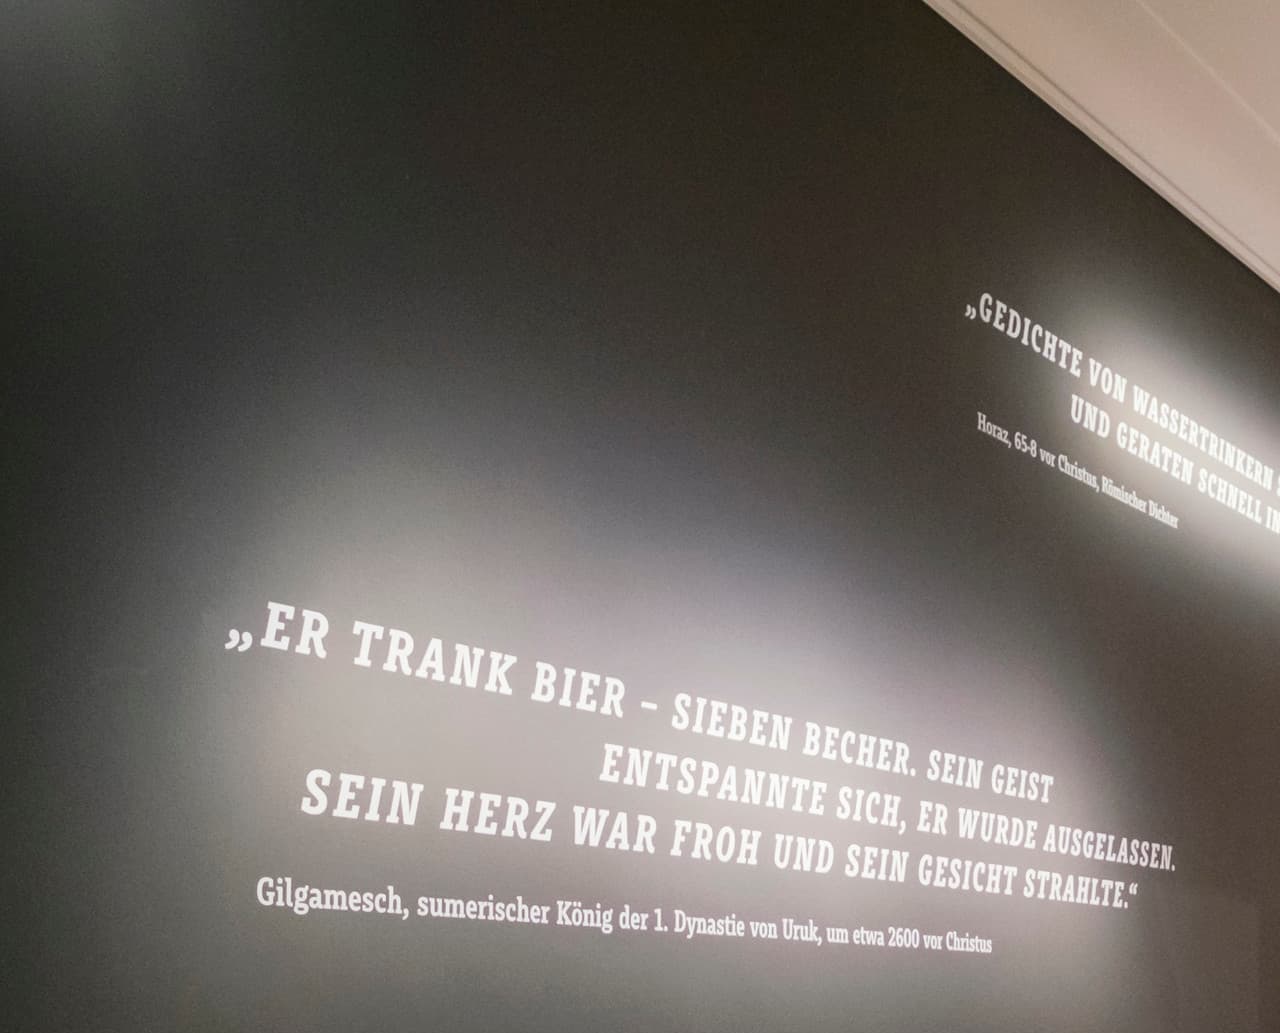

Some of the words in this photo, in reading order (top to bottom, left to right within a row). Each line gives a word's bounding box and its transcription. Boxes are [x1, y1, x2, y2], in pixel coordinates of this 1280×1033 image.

[977, 412, 1011, 449] Horaz,
[1014, 432, 1037, 458] 65-8
[1039, 448, 1055, 468] vor
[1058, 455, 1100, 492] Christus,
[1102, 476, 1147, 514] Römischer
[1148, 500, 1179, 529] Dichter
[1071, 395, 1110, 439] UND
[1117, 423, 1192, 485] GERATEN
[1199, 469, 1262, 524] SCHNELL
[1266, 505, 1280, 534] IN
[1089, 358, 1127, 403] VON
[1133, 385, 1273, 488] WASSERTRINKERN
[353, 621, 517, 695] TRANK
[531, 661, 625, 718] BIER
[671, 693, 792, 751] SIEBEN
[803, 721, 916, 776] BECHER.
[927, 750, 983, 789] SEIN
[991, 764, 1054, 803] GEIST
[301, 769, 424, 826] SEIN
[440, 787, 556, 841] HERZ
[572, 806, 657, 853] WAR
[670, 820, 762, 865] FROH
[773, 833, 834, 873] UND
[845, 844, 908, 882] SEIN
[918, 855, 1018, 896] GESICHT
[599, 743, 827, 816] ENTSPANNTE
[836, 786, 906, 835] SICH,
[917, 800, 948, 835] ER
[958, 807, 1038, 849] WURDE
[1043, 824, 1175, 871] AUSGELASSEN.
[257, 877, 409, 920] Gilgamesch,
[417, 894, 549, 924] sumerischer
[556, 900, 613, 934] König
[619, 905, 648, 930] der
[654, 908, 668, 932] 1.
[674, 909, 744, 939] Dynastie
[750, 919, 777, 939] von
[782, 918, 822, 947] Uruk,
[827, 928, 849, 945] um
[853, 928, 885, 946] etwa
[888, 927, 919, 949] 2600
[923, 934, 943, 951] vor
[946, 931, 992, 953] Christus
